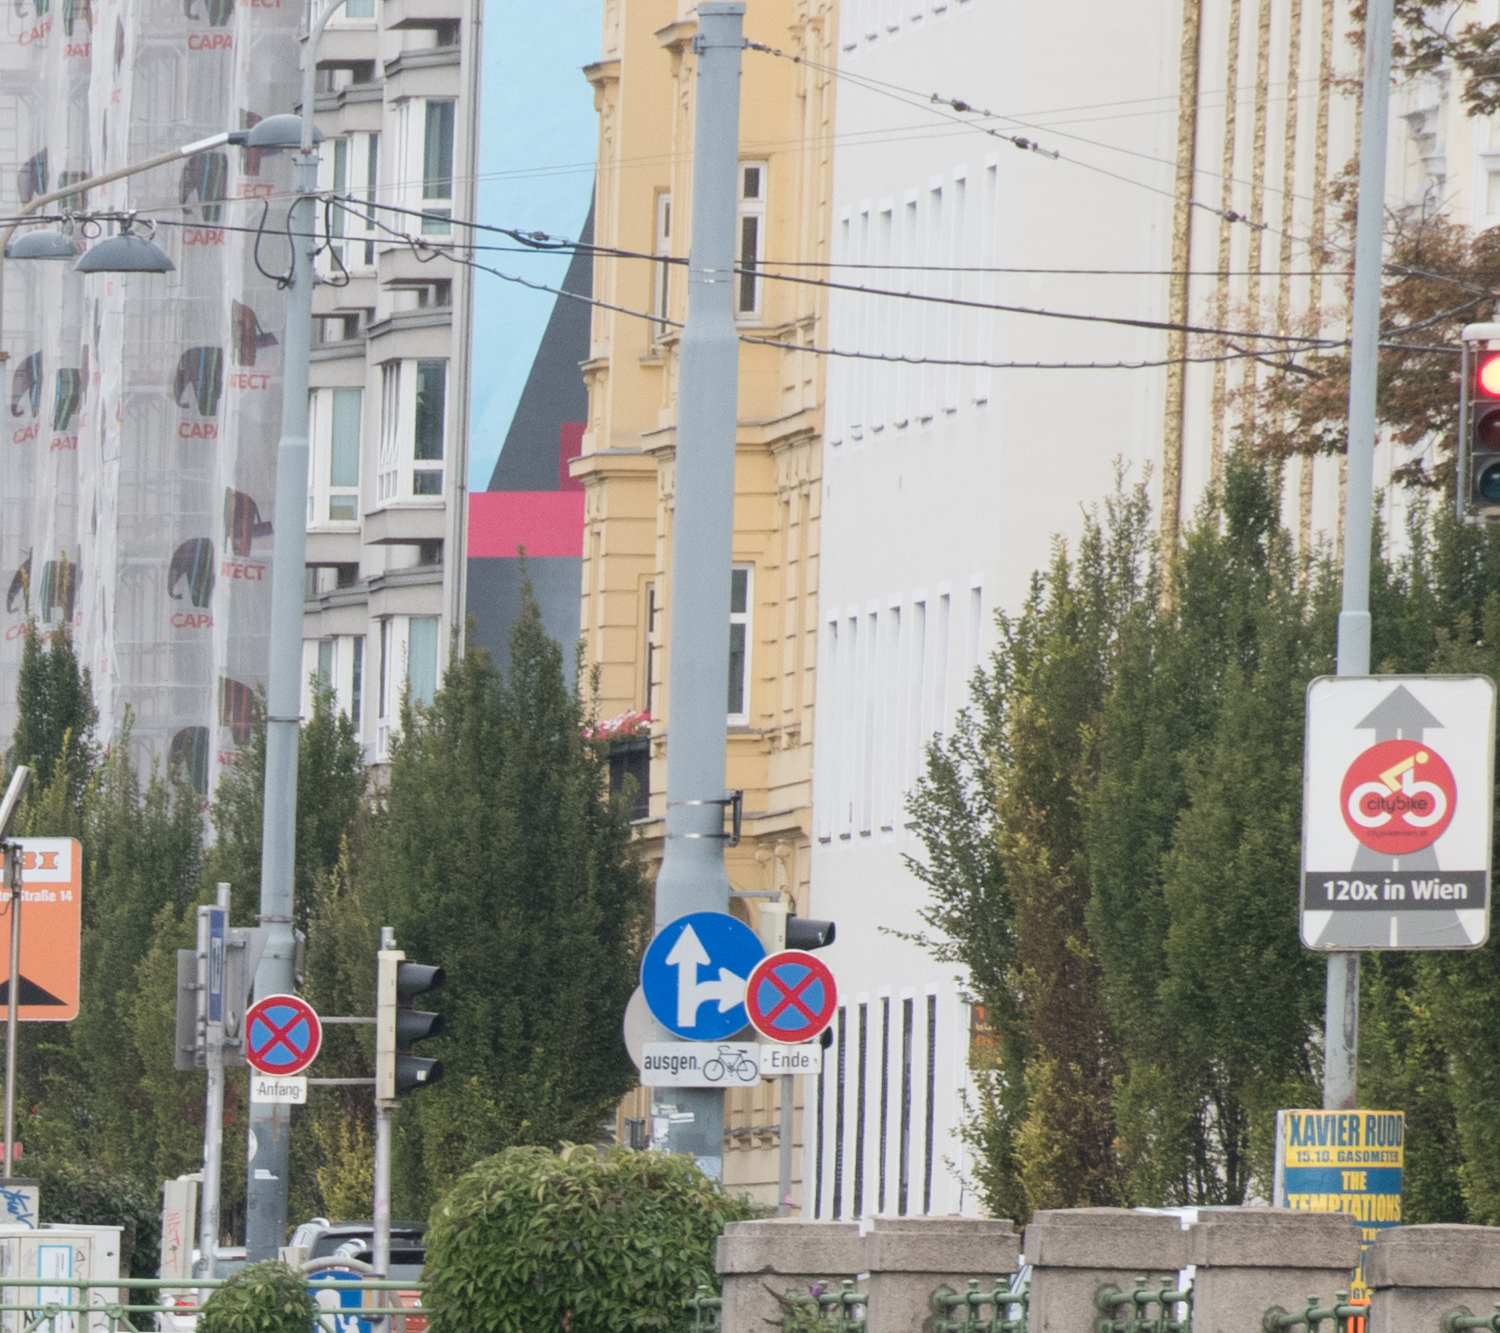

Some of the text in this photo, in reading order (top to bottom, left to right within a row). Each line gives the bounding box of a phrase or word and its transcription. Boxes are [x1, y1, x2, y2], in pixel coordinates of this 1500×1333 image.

[1323, 878, 1468, 901] 120x in Wien
[644, 1054, 702, 1075] ausgen.
[771, 1051, 809, 1068] Ende
[258, 1082, 300, 1099] Anfang
[1289, 1114, 1360, 1147] XAVIER
[1337, 1150, 1399, 1163] GASOMETER
[1341, 1171, 1367, 1191] THE
[1287, 1194, 1401, 1222] TEMPTATIONS
